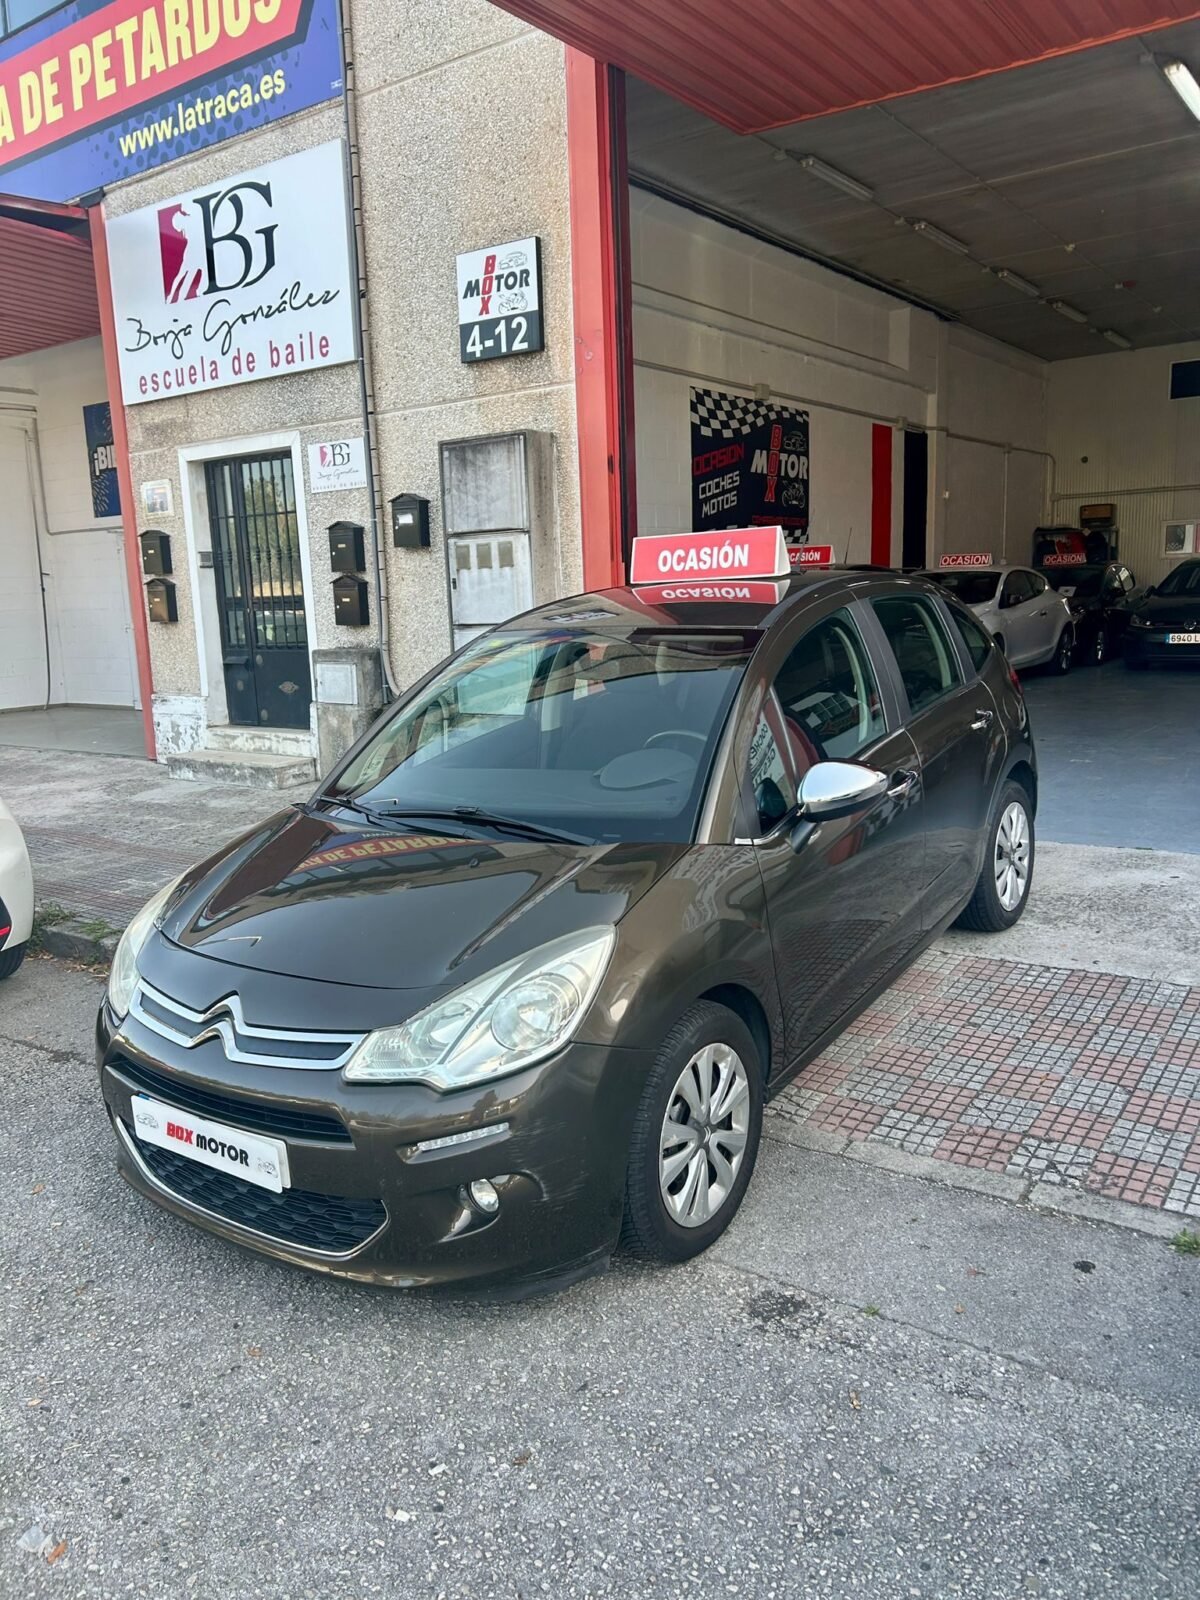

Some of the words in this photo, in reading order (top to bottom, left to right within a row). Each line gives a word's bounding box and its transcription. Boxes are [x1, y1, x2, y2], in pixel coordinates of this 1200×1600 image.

[18, 56, 64, 135] DE
[119, 68, 286, 156] www.latraca.es
[193, 181, 278, 295] BG
[462, 269, 530, 299] MOTOR
[479, 254, 496, 316] BOX
[126, 318, 192, 359] Borja
[203, 281, 340, 355] González
[466, 316, 529, 357] 4-12
[139, 356, 218, 394] escuela
[232, 348, 255, 375] de
[270, 331, 329, 368] baile
[330, 442, 350, 466] BG
[750, 449, 808, 480] MOTOR
[764, 424, 782, 502] BOX
[699, 470, 740, 499] COCHES
[702, 491, 737, 519] MOTOS
[657, 540, 749, 572] OCASIÓN
[790, 550, 820, 562] CASIÓN
[1171, 634, 1192, 642] 6940
[166, 1121, 194, 1145] BOX
[196, 1133, 249, 1167] MOTOR
